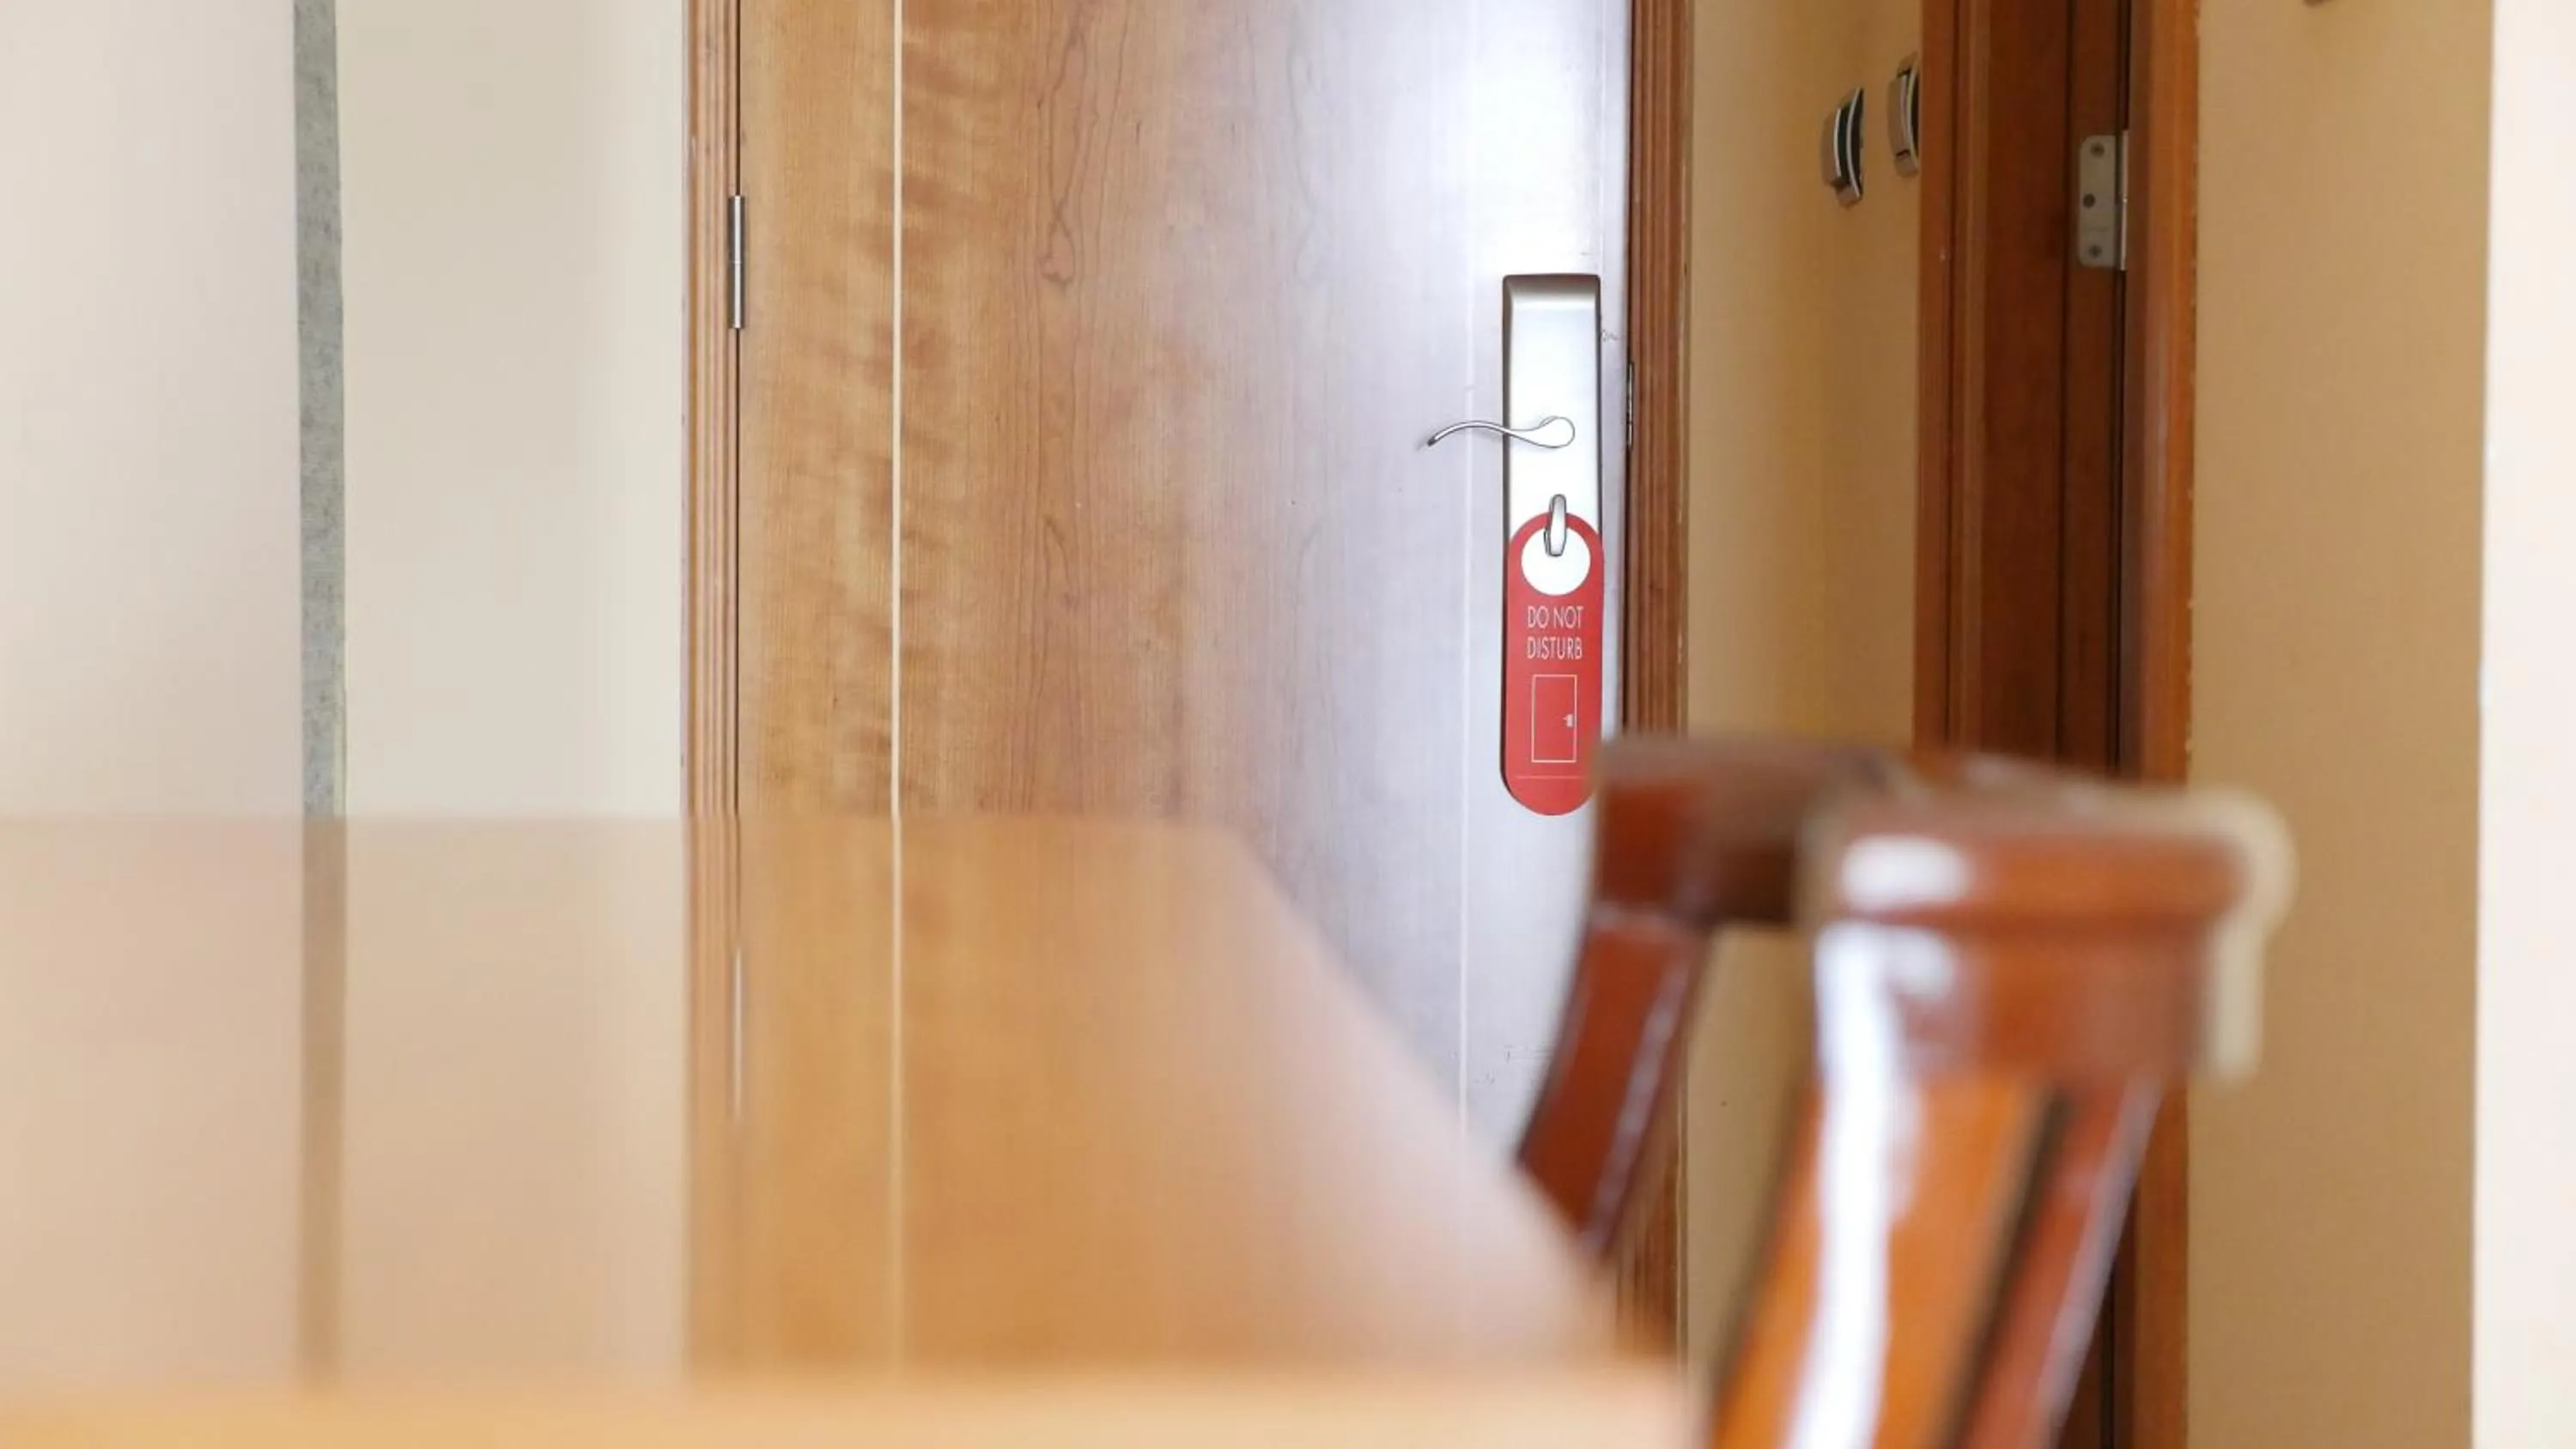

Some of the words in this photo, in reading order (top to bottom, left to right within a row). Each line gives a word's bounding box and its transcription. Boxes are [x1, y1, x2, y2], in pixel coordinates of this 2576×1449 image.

[1528, 605, 1549, 628] DO
[1553, 605, 1584, 628] NOT
[1527, 636, 1583, 659] DISTURB
